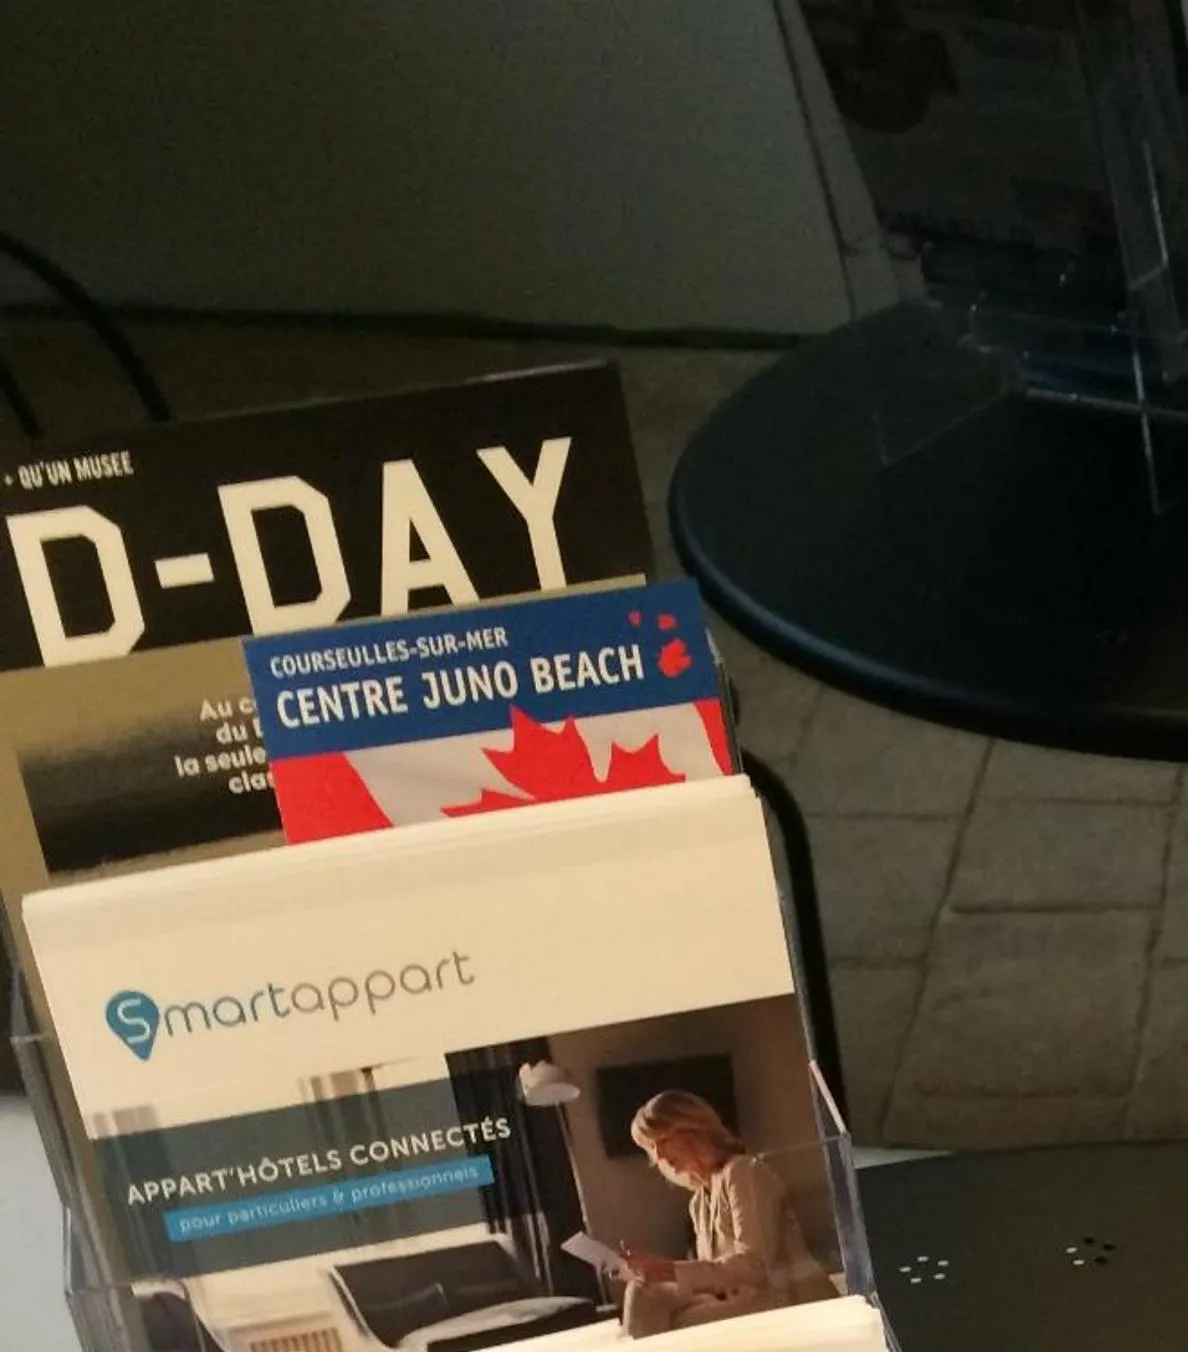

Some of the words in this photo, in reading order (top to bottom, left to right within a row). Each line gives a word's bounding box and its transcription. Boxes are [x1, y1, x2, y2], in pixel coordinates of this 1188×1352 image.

[18, 461, 72, 490] QU'UN
[5, 436, 572, 667] D-DAY
[270, 626, 509, 679] COURSEULLES-SUR-MER
[200, 698, 233, 721] Au
[276, 676, 408, 729] CENTRE
[421, 660, 519, 709] JUNO
[529, 643, 645, 694] BEACH
[216, 721, 248, 745] du
[174, 755, 200, 778] la
[205, 745, 267, 773] seule
[126, 1151, 343, 1206] APPART'HÔTELS
[349, 1116, 512, 1165] CONNECTÉS
[179, 1213, 223, 1233] pour
[228, 1195, 330, 1225] particuliers
[350, 1164, 480, 1203] professionnels
